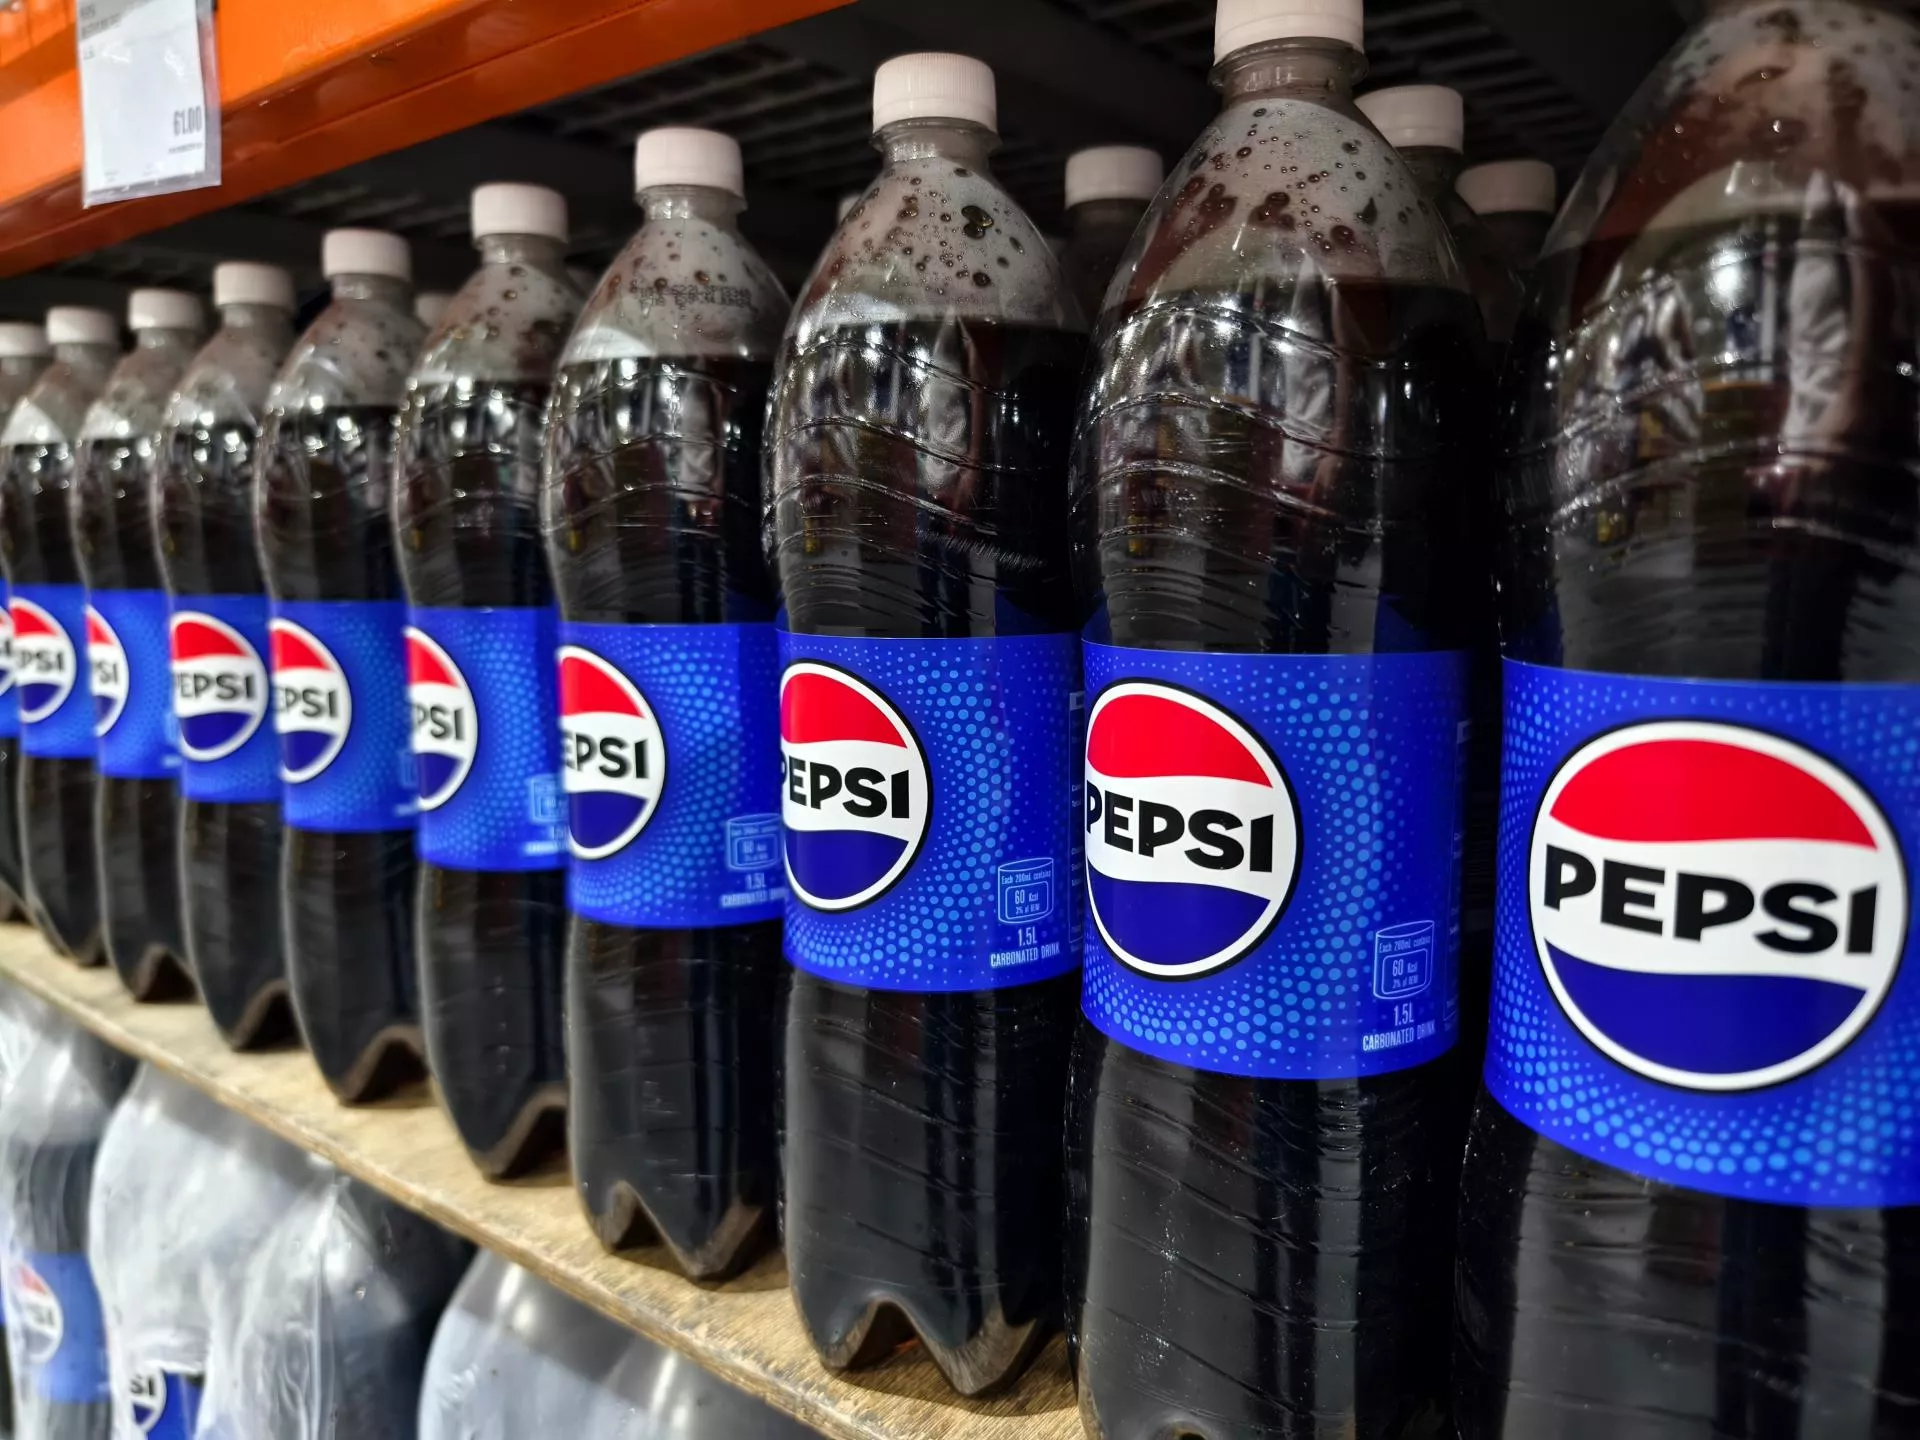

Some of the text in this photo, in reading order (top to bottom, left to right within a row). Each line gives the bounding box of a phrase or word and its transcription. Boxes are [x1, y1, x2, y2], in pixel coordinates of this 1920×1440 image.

[1086, 780, 1274, 873] PEPSI
[1015, 889, 1025, 904] 60
[1543, 843, 1879, 955] PEPSI
[1018, 926, 1038, 947] 1.5L
[990, 942, 1060, 968] CARBONATED DRINK
[1392, 959, 1404, 977] 60
[1394, 1000, 1414, 1026] 1.5L
[1363, 1019, 1436, 1052] CARBONATED DRINK
